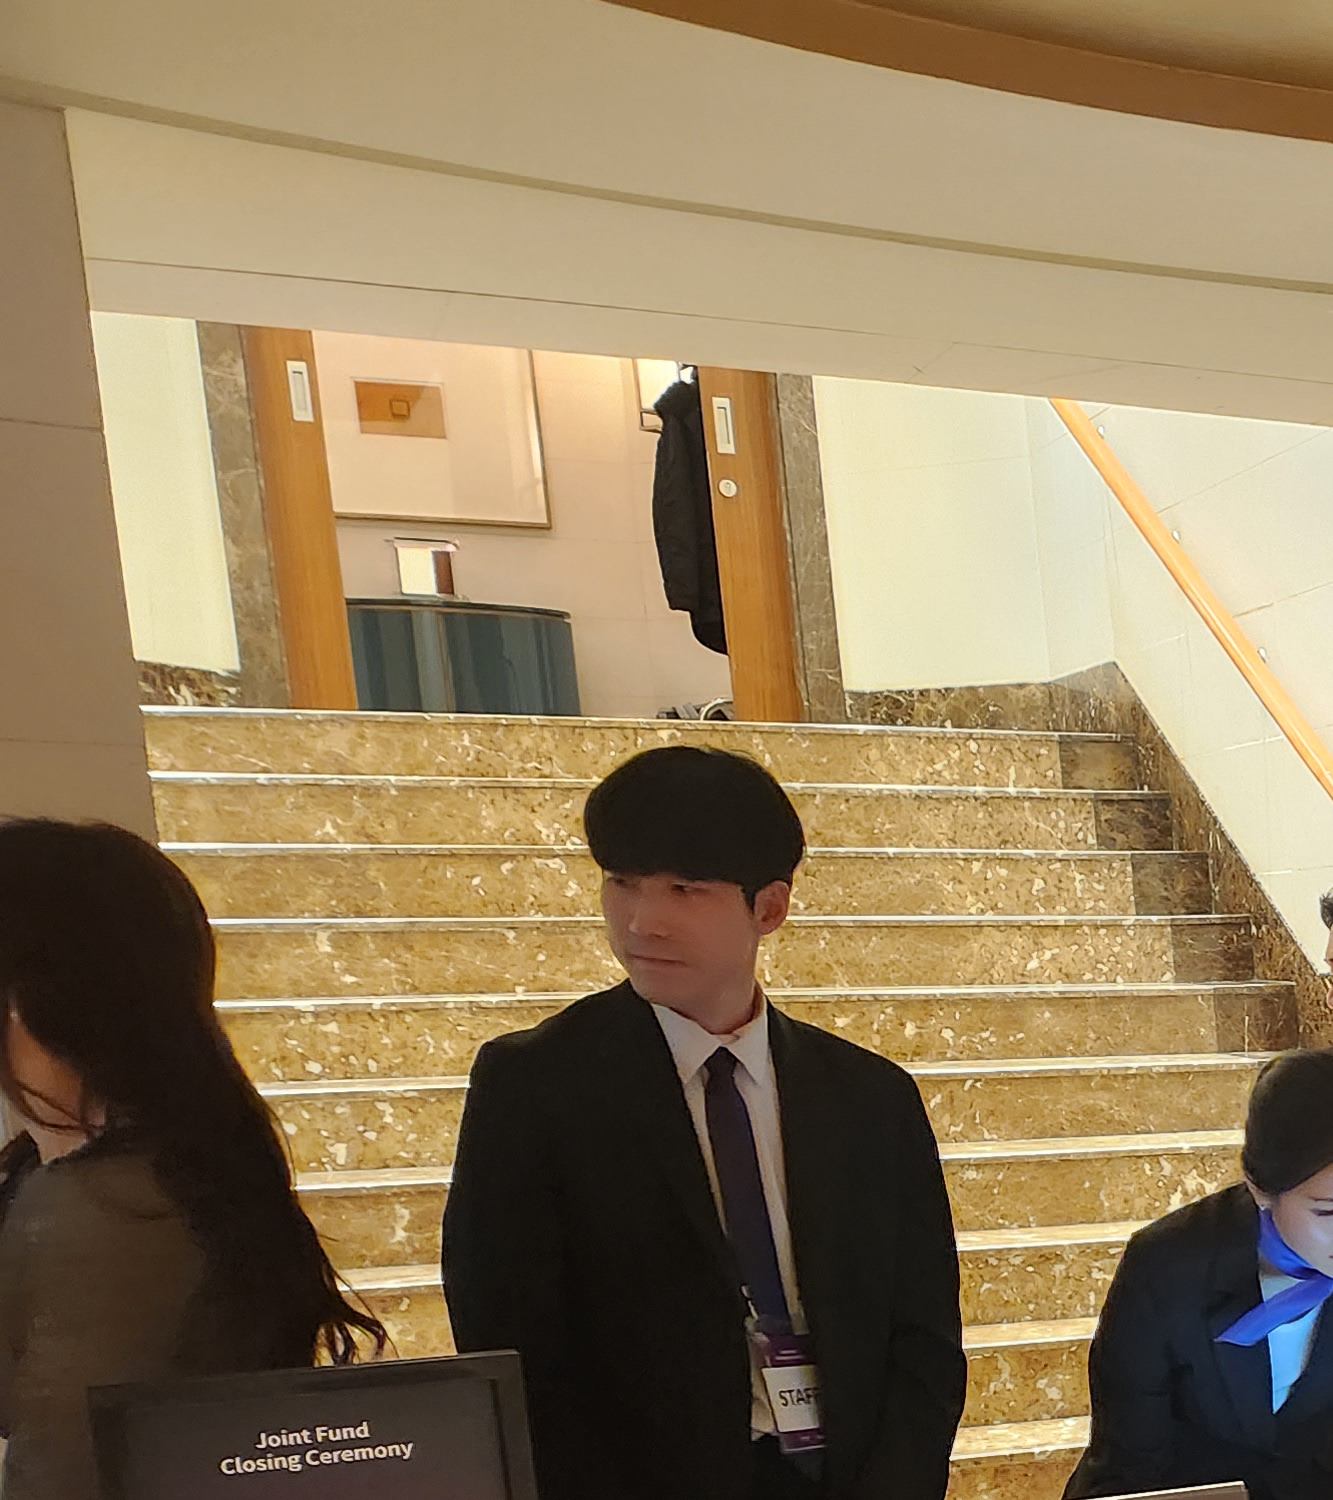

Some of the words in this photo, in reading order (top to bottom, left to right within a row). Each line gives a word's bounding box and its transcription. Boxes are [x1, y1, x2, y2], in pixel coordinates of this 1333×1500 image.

[255, 1429, 314, 1449] Joint
[315, 1421, 370, 1443] Fund
[220, 1453, 303, 1475] Closing
[305, 1442, 414, 1467] Ceremony
